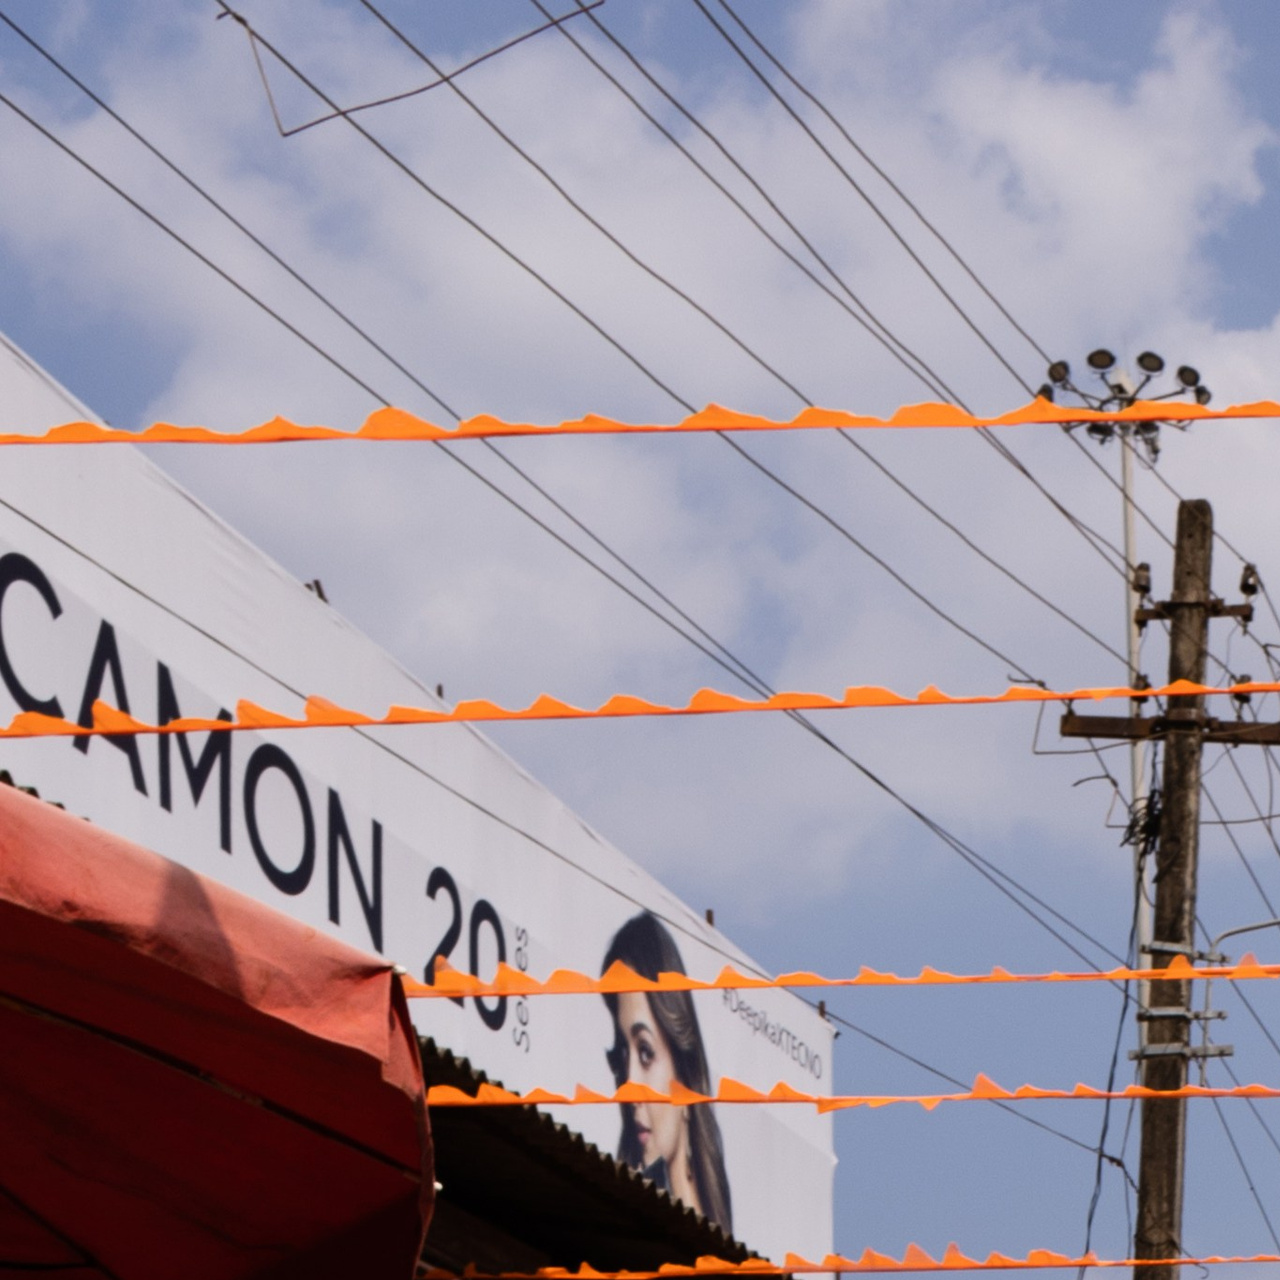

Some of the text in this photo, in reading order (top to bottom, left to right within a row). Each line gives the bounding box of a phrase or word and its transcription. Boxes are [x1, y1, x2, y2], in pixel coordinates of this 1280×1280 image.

[0, 552, 507, 1032] CAMON 20
[513, 927, 530, 1053] Sees
